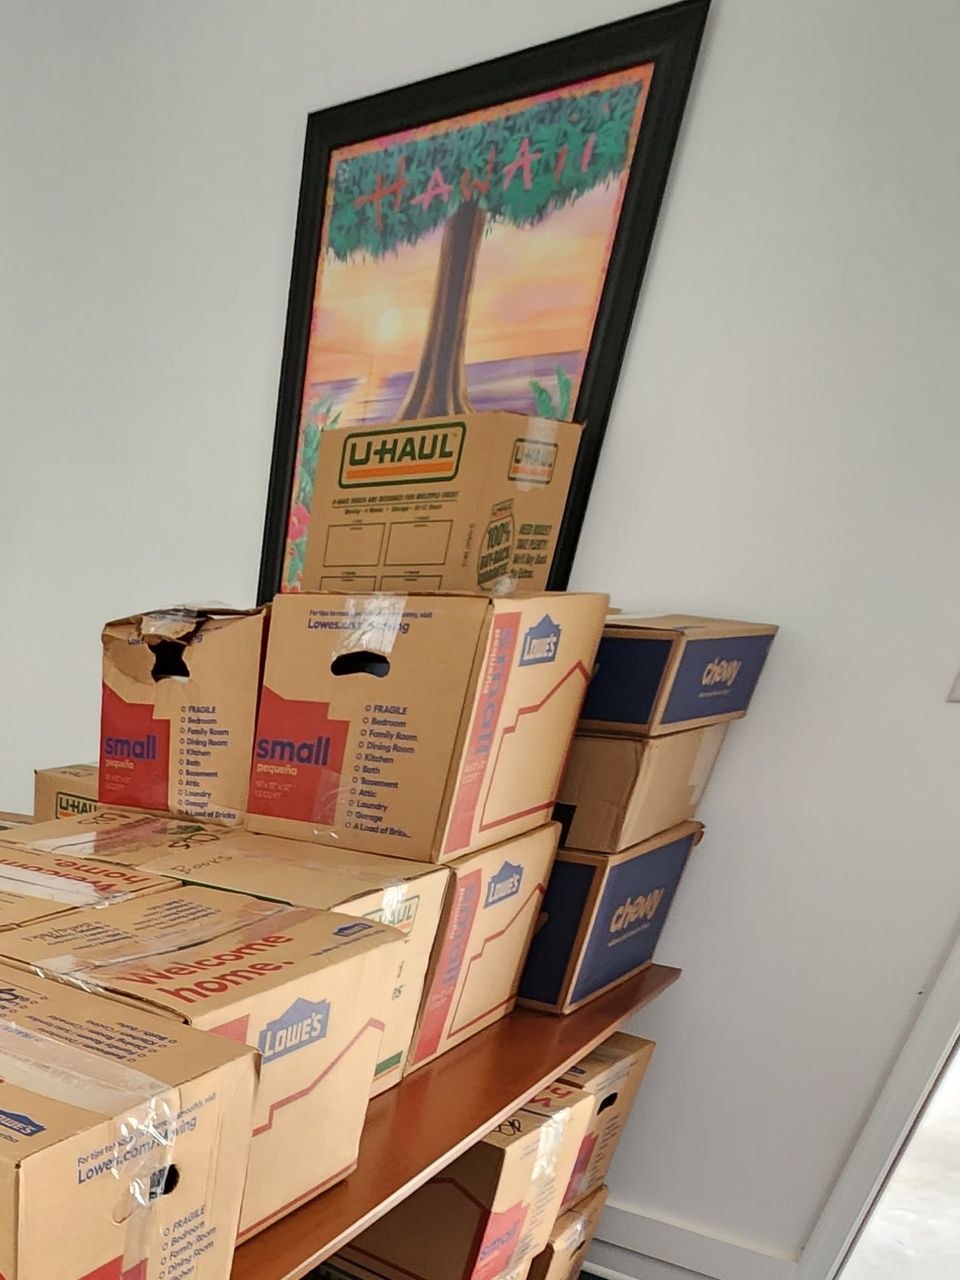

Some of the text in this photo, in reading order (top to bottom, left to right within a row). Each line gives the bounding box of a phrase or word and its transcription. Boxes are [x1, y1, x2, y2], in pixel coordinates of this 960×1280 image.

[349, 434, 453, 466] U-HAUL
[523, 633, 556, 661] LOWE'S
[702, 659, 741, 688] chewy
[476, 628, 511, 754] small
[188, 706, 216, 714] FRAGILE
[373, 705, 408, 715] FRAGILE
[187, 717, 217, 725] Bedroom
[371, 717, 406, 728] Bedroom
[187, 727, 229, 736] Family Room
[369, 730, 395, 741] Family
[105, 735, 157, 760] small
[187, 738, 228, 748] Dining Room
[367, 741, 415, 754] Dining Room
[186, 749, 211, 757] Kitchen
[256, 736, 331, 766] small
[186, 759, 201, 767] Bath
[365, 753, 394, 764] Kitchen
[185, 770, 218, 778] Basement
[257, 763, 297, 776] pequeña
[362, 765, 380, 775] Bath
[360, 777, 399, 789] Basement
[184, 790, 212, 799] Laundry
[358, 789, 377, 798] Attic
[356, 800, 388, 812] Laundry
[190, 810, 206, 818] Load
[215, 812, 236, 820] Bricks
[355, 812, 383, 822] Garage
[359, 823, 379, 834] Load
[55, 858, 150, 885] home.
[490, 873, 519, 903] LOWE'S
[609, 888, 664, 933] chewy
[443, 883, 474, 986] small
[115, 934, 295, 986] Welcome
[156, 960, 295, 1004] home.
[264, 1012, 323, 1057] LOWE'S
[173, 1204, 206, 1233] FRAGILE
[171, 1220, 205, 1247] Bedroom
[169, 1227, 216, 1262] Family Room
[480, 1221, 518, 1261] small
[168, 1241, 214, 1275] Dining Room
